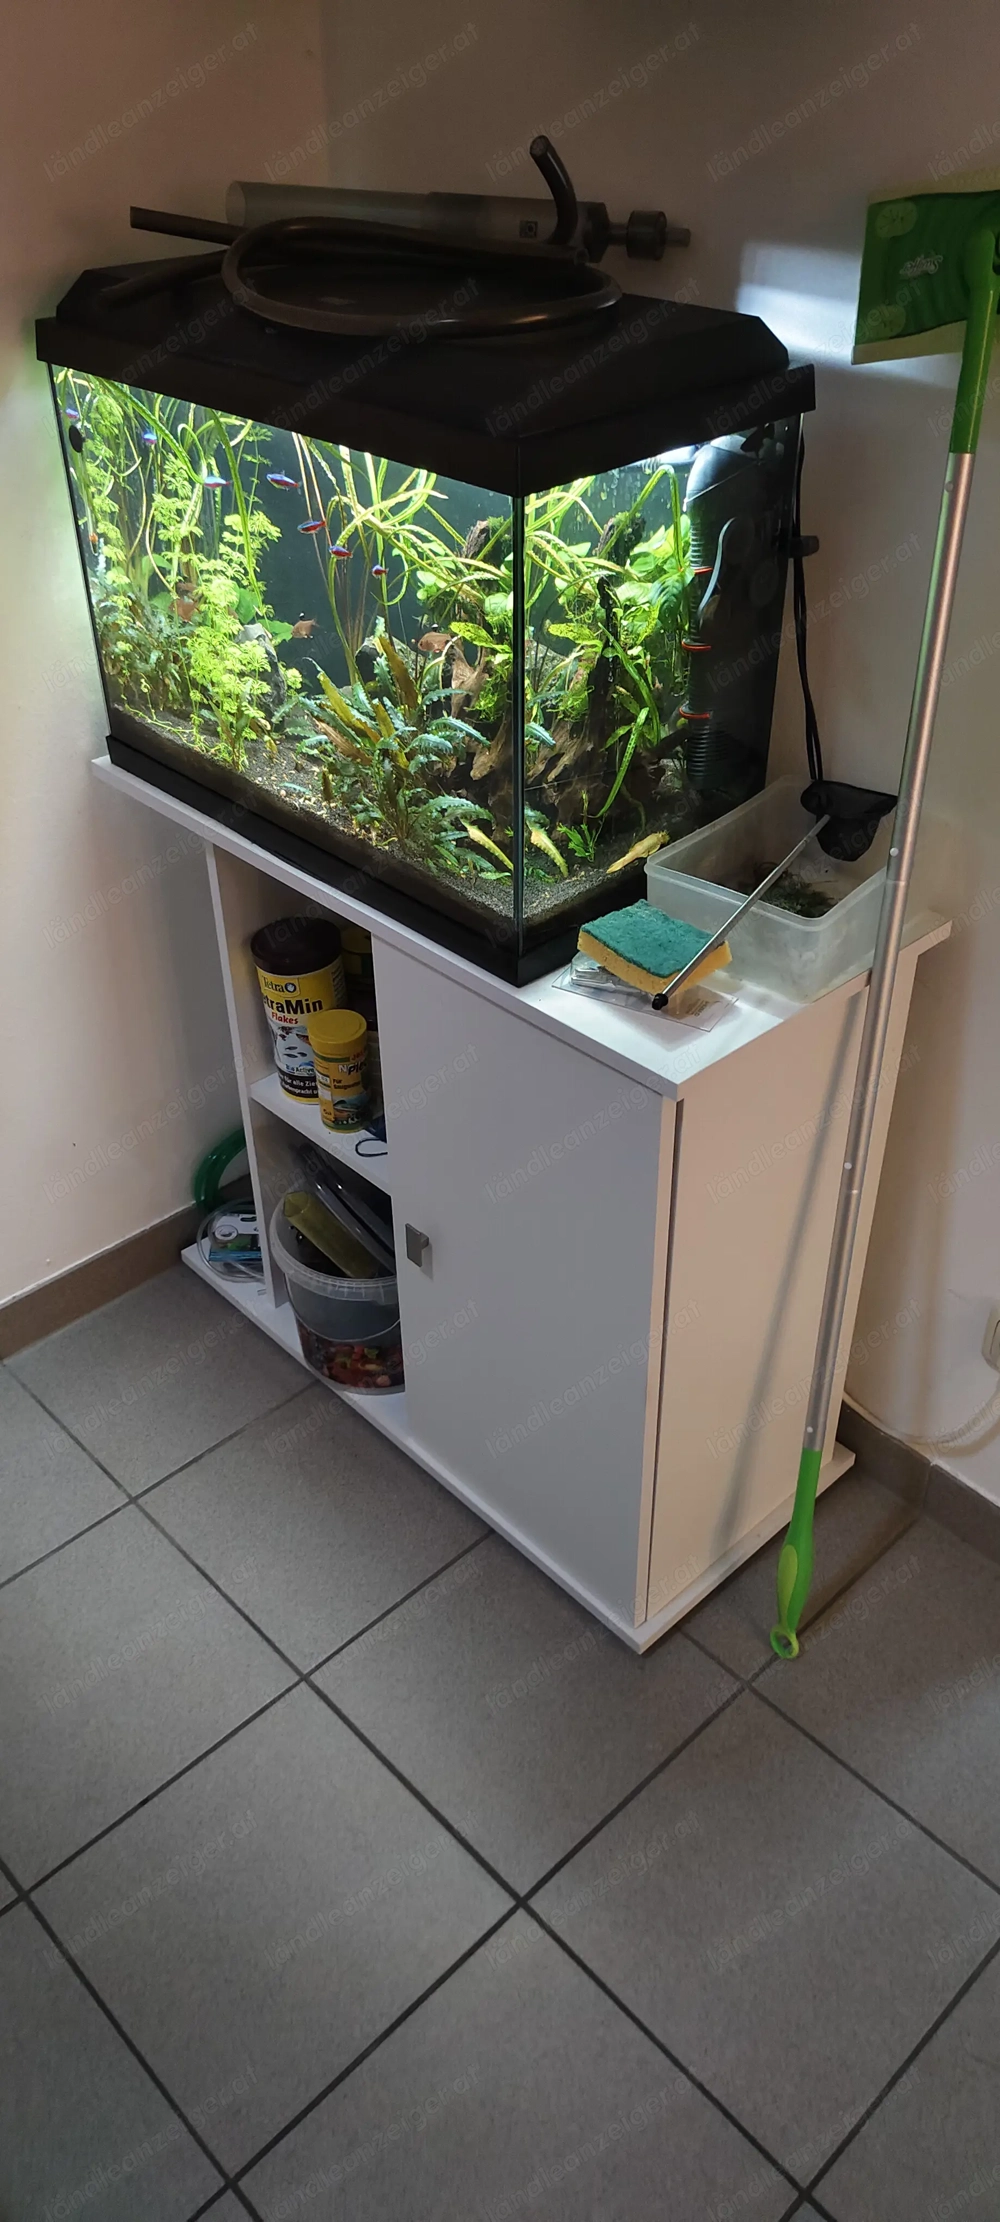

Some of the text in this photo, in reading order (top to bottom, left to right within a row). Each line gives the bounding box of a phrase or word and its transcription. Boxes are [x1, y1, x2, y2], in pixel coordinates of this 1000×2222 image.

[261, 976, 285, 992] Tetra
[263, 994, 324, 1015] traMin
[271, 1012, 299, 1025] Flakes
[305, 1080, 317, 1088] Zie
